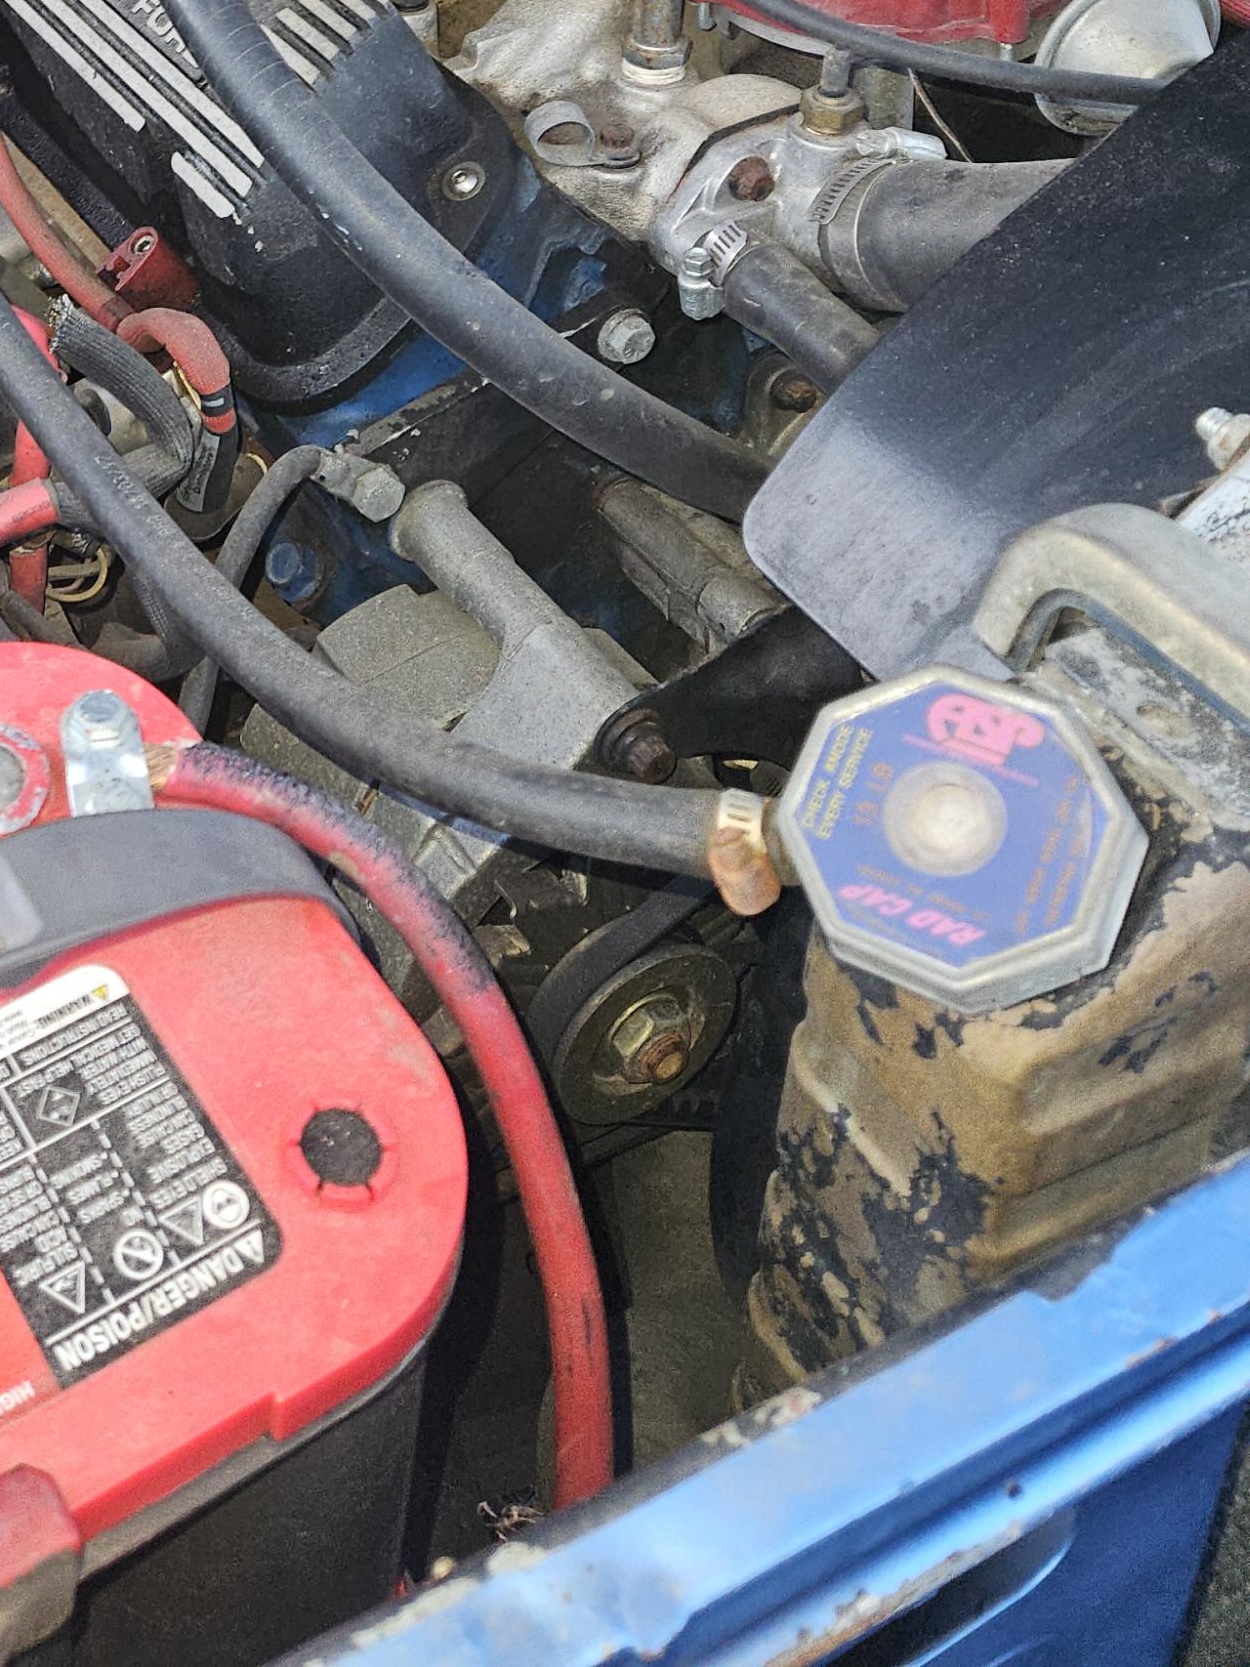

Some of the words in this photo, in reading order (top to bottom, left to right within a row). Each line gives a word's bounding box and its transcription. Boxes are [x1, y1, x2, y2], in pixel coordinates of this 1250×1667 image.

[837, 725, 873, 790] SERVICE
[839, 883, 916, 918] CAP
[909, 906, 986, 946] RAD
[32, 992, 93, 1032] WARNING:
[41, 1057, 74, 1083] HELP
[68, 1033, 120, 1069] MEDICAL
[157, 1119, 207, 1157] GASES
[48, 1152, 104, 1191] SMOKING
[144, 1134, 216, 1185] EXPLOSIVE
[177, 1154, 229, 1194] SHIELD
[64, 1169, 114, 1207] FLAMES
[75, 1188, 125, 1225] SPARKS
[148, 1182, 184, 1212] EYES
[32, 1223, 70, 1255] ACID
[9, 1239, 80, 1288] SULFURIC
[49, 1242, 247, 1374] DANGER/POISON
